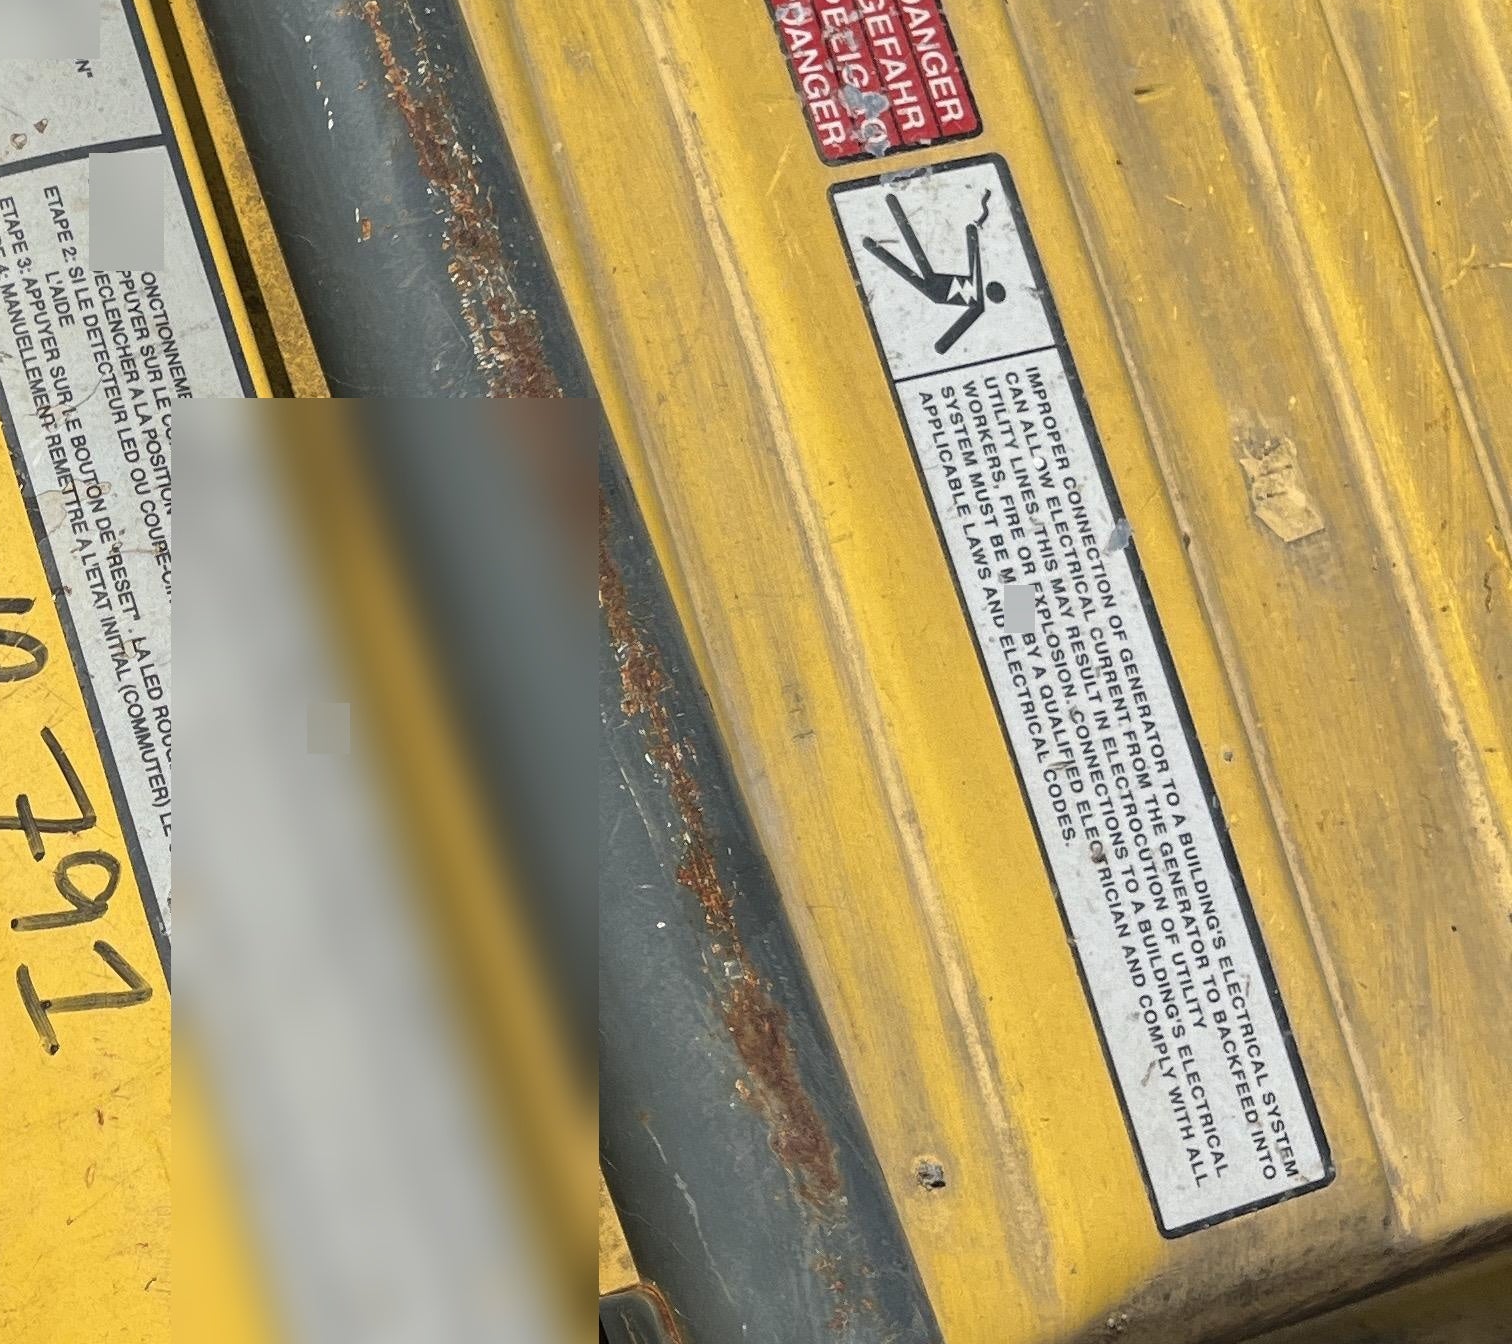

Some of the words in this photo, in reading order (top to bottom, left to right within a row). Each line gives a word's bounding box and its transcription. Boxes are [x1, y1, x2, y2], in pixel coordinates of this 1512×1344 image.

[776, 1, 847, 147] DANGER
[42, 184, 74, 243] ETAPE
[14, 256, 35, 274] 3:
[60, 245, 80, 263] 2:
[65, 264, 87, 285] SI
[20, 275, 62, 362] APPUYER
[43, 270, 76, 328] L'AIDE
[72, 286, 95, 311] LE
[47, 364, 74, 403] SUR
[81, 313, 130, 424] DETECTEUR
[1002, 369, 1030, 414] CAN
[115, 426, 142, 463] LED
[981, 375, 1019, 452] UTILITY
[1024, 365, 1071, 471] IMPROPER
[68, 434, 108, 514] BOUTON
[127, 466, 152, 496] OU
[93, 515, 117, 543] DE
[1031, 525, 1060, 573] THIS
[1044, 494, 1099, 623] ELECTRICAL
[1060, 474, 1117, 609] CONNECTION
[43, 433, 90, 535] REMETTRE
[79, 552, 113, 614] L'ETAT
[98, 613, 135, 683] INITIAL
[117, 682, 172, 809] (COMMUTER)
[917, 389, 972, 518] APPLICABLE
[961, 521, 993, 581] LAWS
[997, 633, 1052, 764] ELECTRICAL
[1039, 763, 1079, 848] CODES.
[1048, 576, 1075, 621] MAY
[1106, 613, 1128, 643] OF
[138, 662, 165, 702] LED
[1064, 624, 1103, 705] RESULT
[1087, 625, 1133, 726] CURRENT
[1091, 708, 1111, 731] IN
[1116, 646, 1171, 774] GENERATOR
[939, 384, 978, 467] SYSTEM
[967, 471, 999, 530] MUST
[988, 533, 1010, 562] BE
[1020, 631, 1043, 660] BY
[1036, 682, 1086, 795] QUALIFIED
[1120, 943, 1148, 989] AND
[1135, 993, 1178, 1082] COMPLY
[1165, 1085, 1196, 1141] WITH
[1184, 1145, 1211, 1188] ALL
[958, 379, 1009, 490] WORKERS,
[998, 493, 1026, 541] FIRE
[1014, 543, 1038, 576] OR
[1066, 704, 1130, 860] CONNECTIONS
[1118, 863, 1141, 895] TO
[1135, 918, 1187, 1039] BUILDING'S
[1175, 1043, 1232, 1178] ELECTRICAL
[1120, 729, 1153, 789] FROM
[1159, 777, 1182, 808] TO
[1100, 736, 1170, 913] ELECTROCUTION
[1141, 792, 1169, 837] THE
[1156, 839, 1211, 970] GENERATOR
[1176, 831, 1228, 951] BUILDING'S
[1157, 916, 1181, 946] OF
[1169, 950, 1208, 1031] UTILITY
[1199, 973, 1222, 1004] TO
[1216, 954, 1272, 1087] ELECTRICAL
[1210, 1009, 1262, 1130] BACKFEED
[1249, 1129, 1279, 1181] INTO
[1258, 1090, 1301, 1178] SYSTEM
